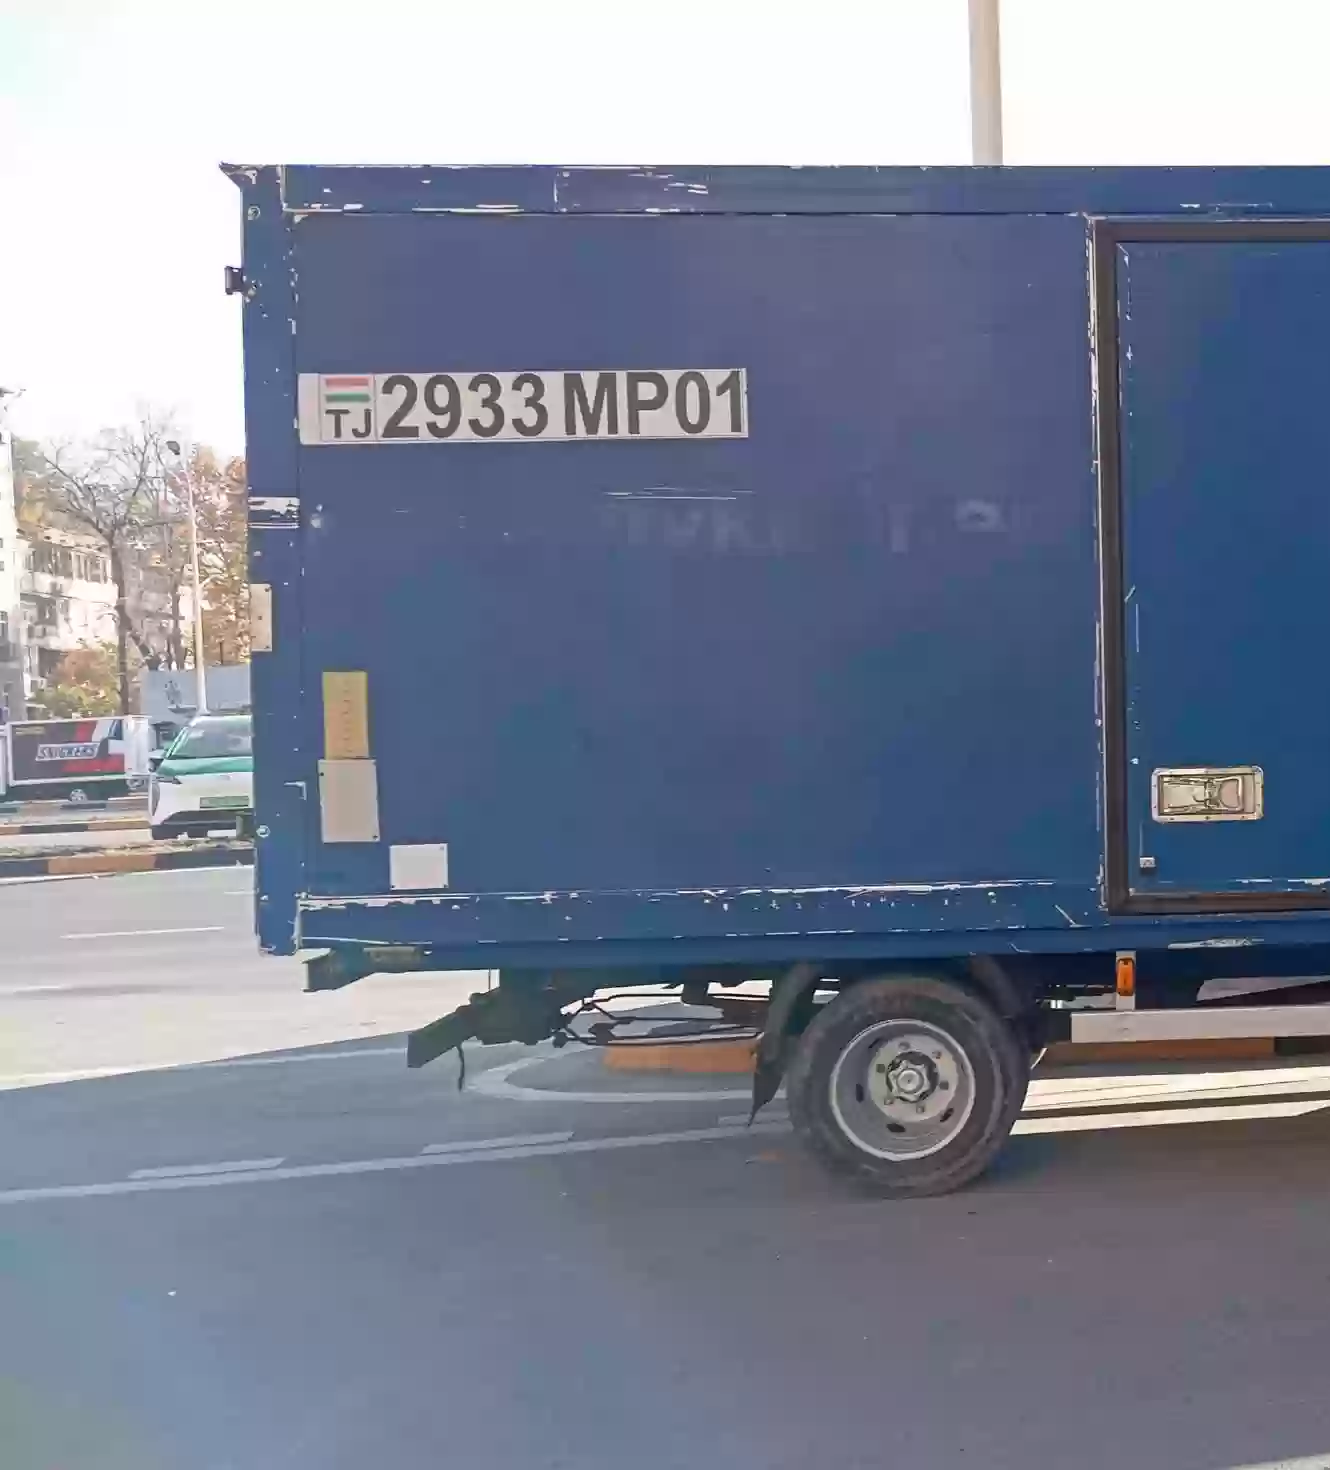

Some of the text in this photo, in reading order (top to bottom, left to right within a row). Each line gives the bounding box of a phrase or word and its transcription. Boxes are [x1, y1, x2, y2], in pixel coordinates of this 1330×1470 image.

[324, 371, 744, 439] TJ 2933 MP01
